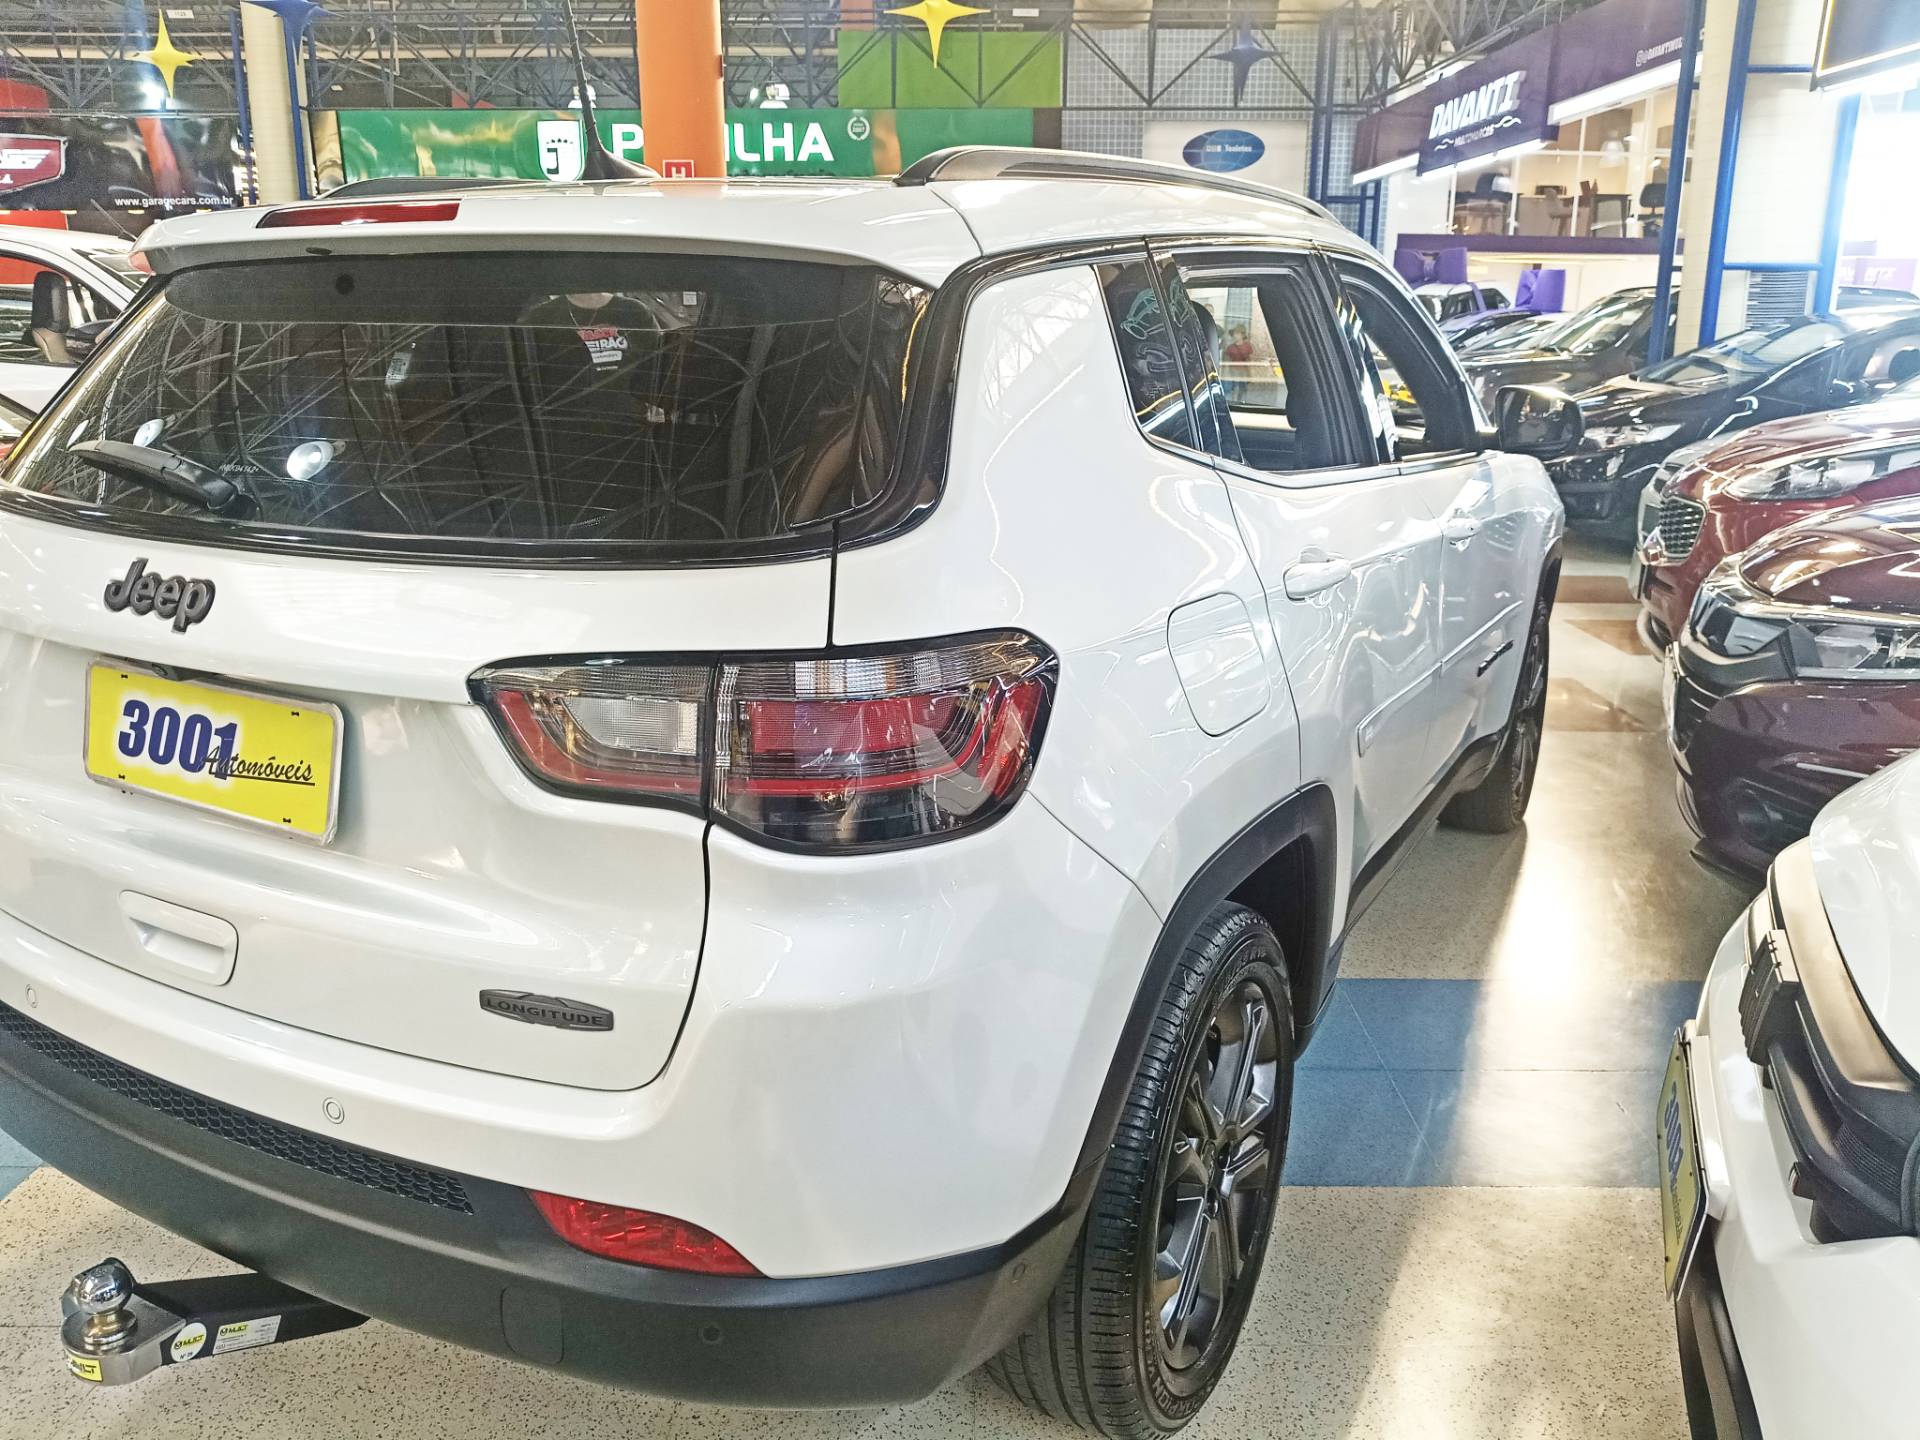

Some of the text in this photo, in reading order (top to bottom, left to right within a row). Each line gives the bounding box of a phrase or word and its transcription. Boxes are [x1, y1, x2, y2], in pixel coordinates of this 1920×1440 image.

[1428, 71, 1525, 140] DAVANTI
[611, 122, 834, 162] PILHA
[114, 195, 234, 208] www.garagecars.com.br
[104, 557, 216, 634] Jeep
[118, 699, 238, 781] 3001
[199, 746, 314, 784] Automóveis
[486, 998, 604, 1026] LONGITUDE
